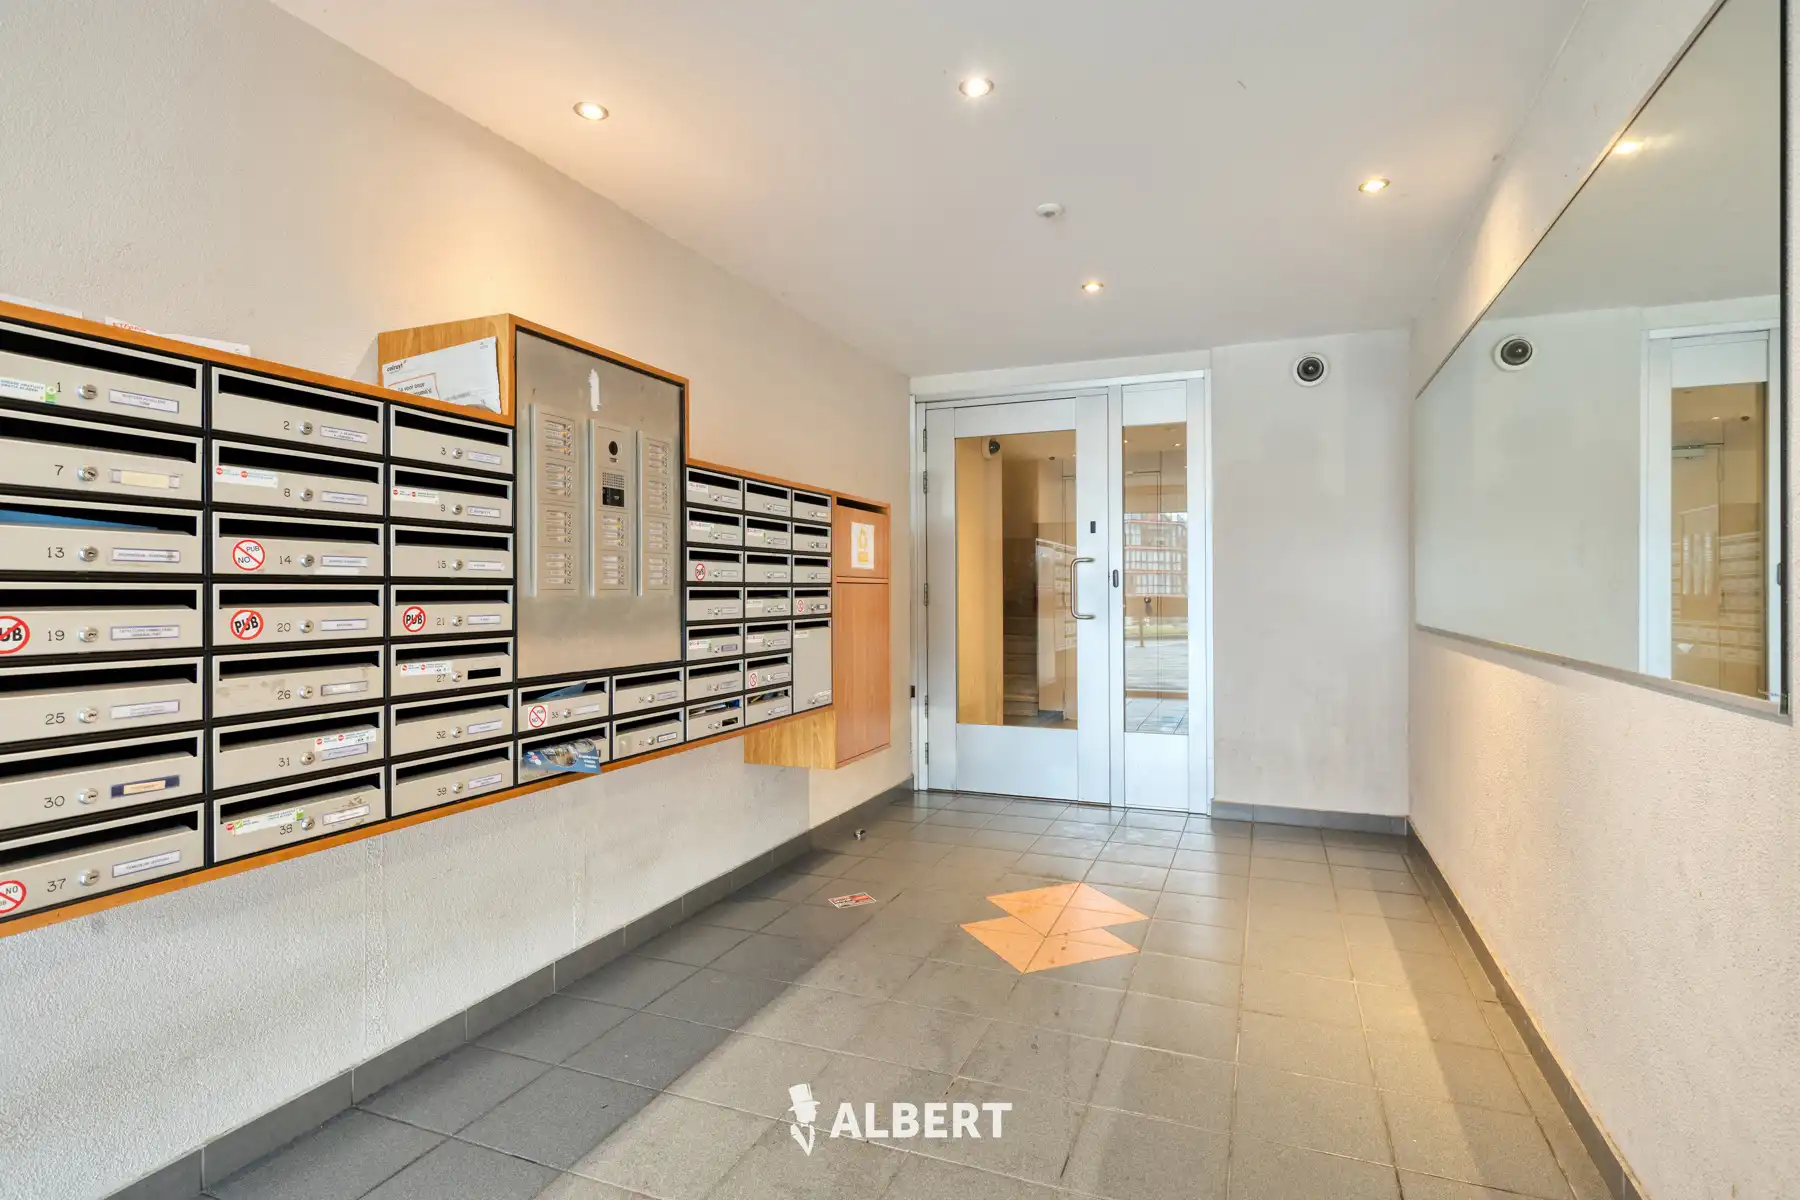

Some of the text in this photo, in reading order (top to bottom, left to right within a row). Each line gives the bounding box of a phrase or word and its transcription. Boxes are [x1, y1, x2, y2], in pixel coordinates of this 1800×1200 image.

[56, 382, 62, 393] 1
[284, 421, 290, 430] 2
[441, 447, 446, 455] 3
[54, 464, 64, 475] 7
[284, 488, 290, 497] 8
[47, 547, 65, 558] 13
[238, 556, 251, 564] NO
[279, 555, 291, 564] 14
[235, 616, 259, 632] PUB
[406, 613, 423, 625] PUB
[436, 617, 445, 626] 21
[277, 622, 291, 632] 20
[47, 630, 65, 641] 19
[436, 674, 446, 683] 27
[277, 690, 291, 700] 26
[45, 712, 65, 725] 25
[436, 731, 446, 739] 32
[278, 757, 290, 767] 31
[436, 787, 447, 796] 39
[44, 795, 65, 809] 30
[279, 825, 293, 835] 38
[5, 885, 18, 895] NO
[47, 878, 66, 893] 37
